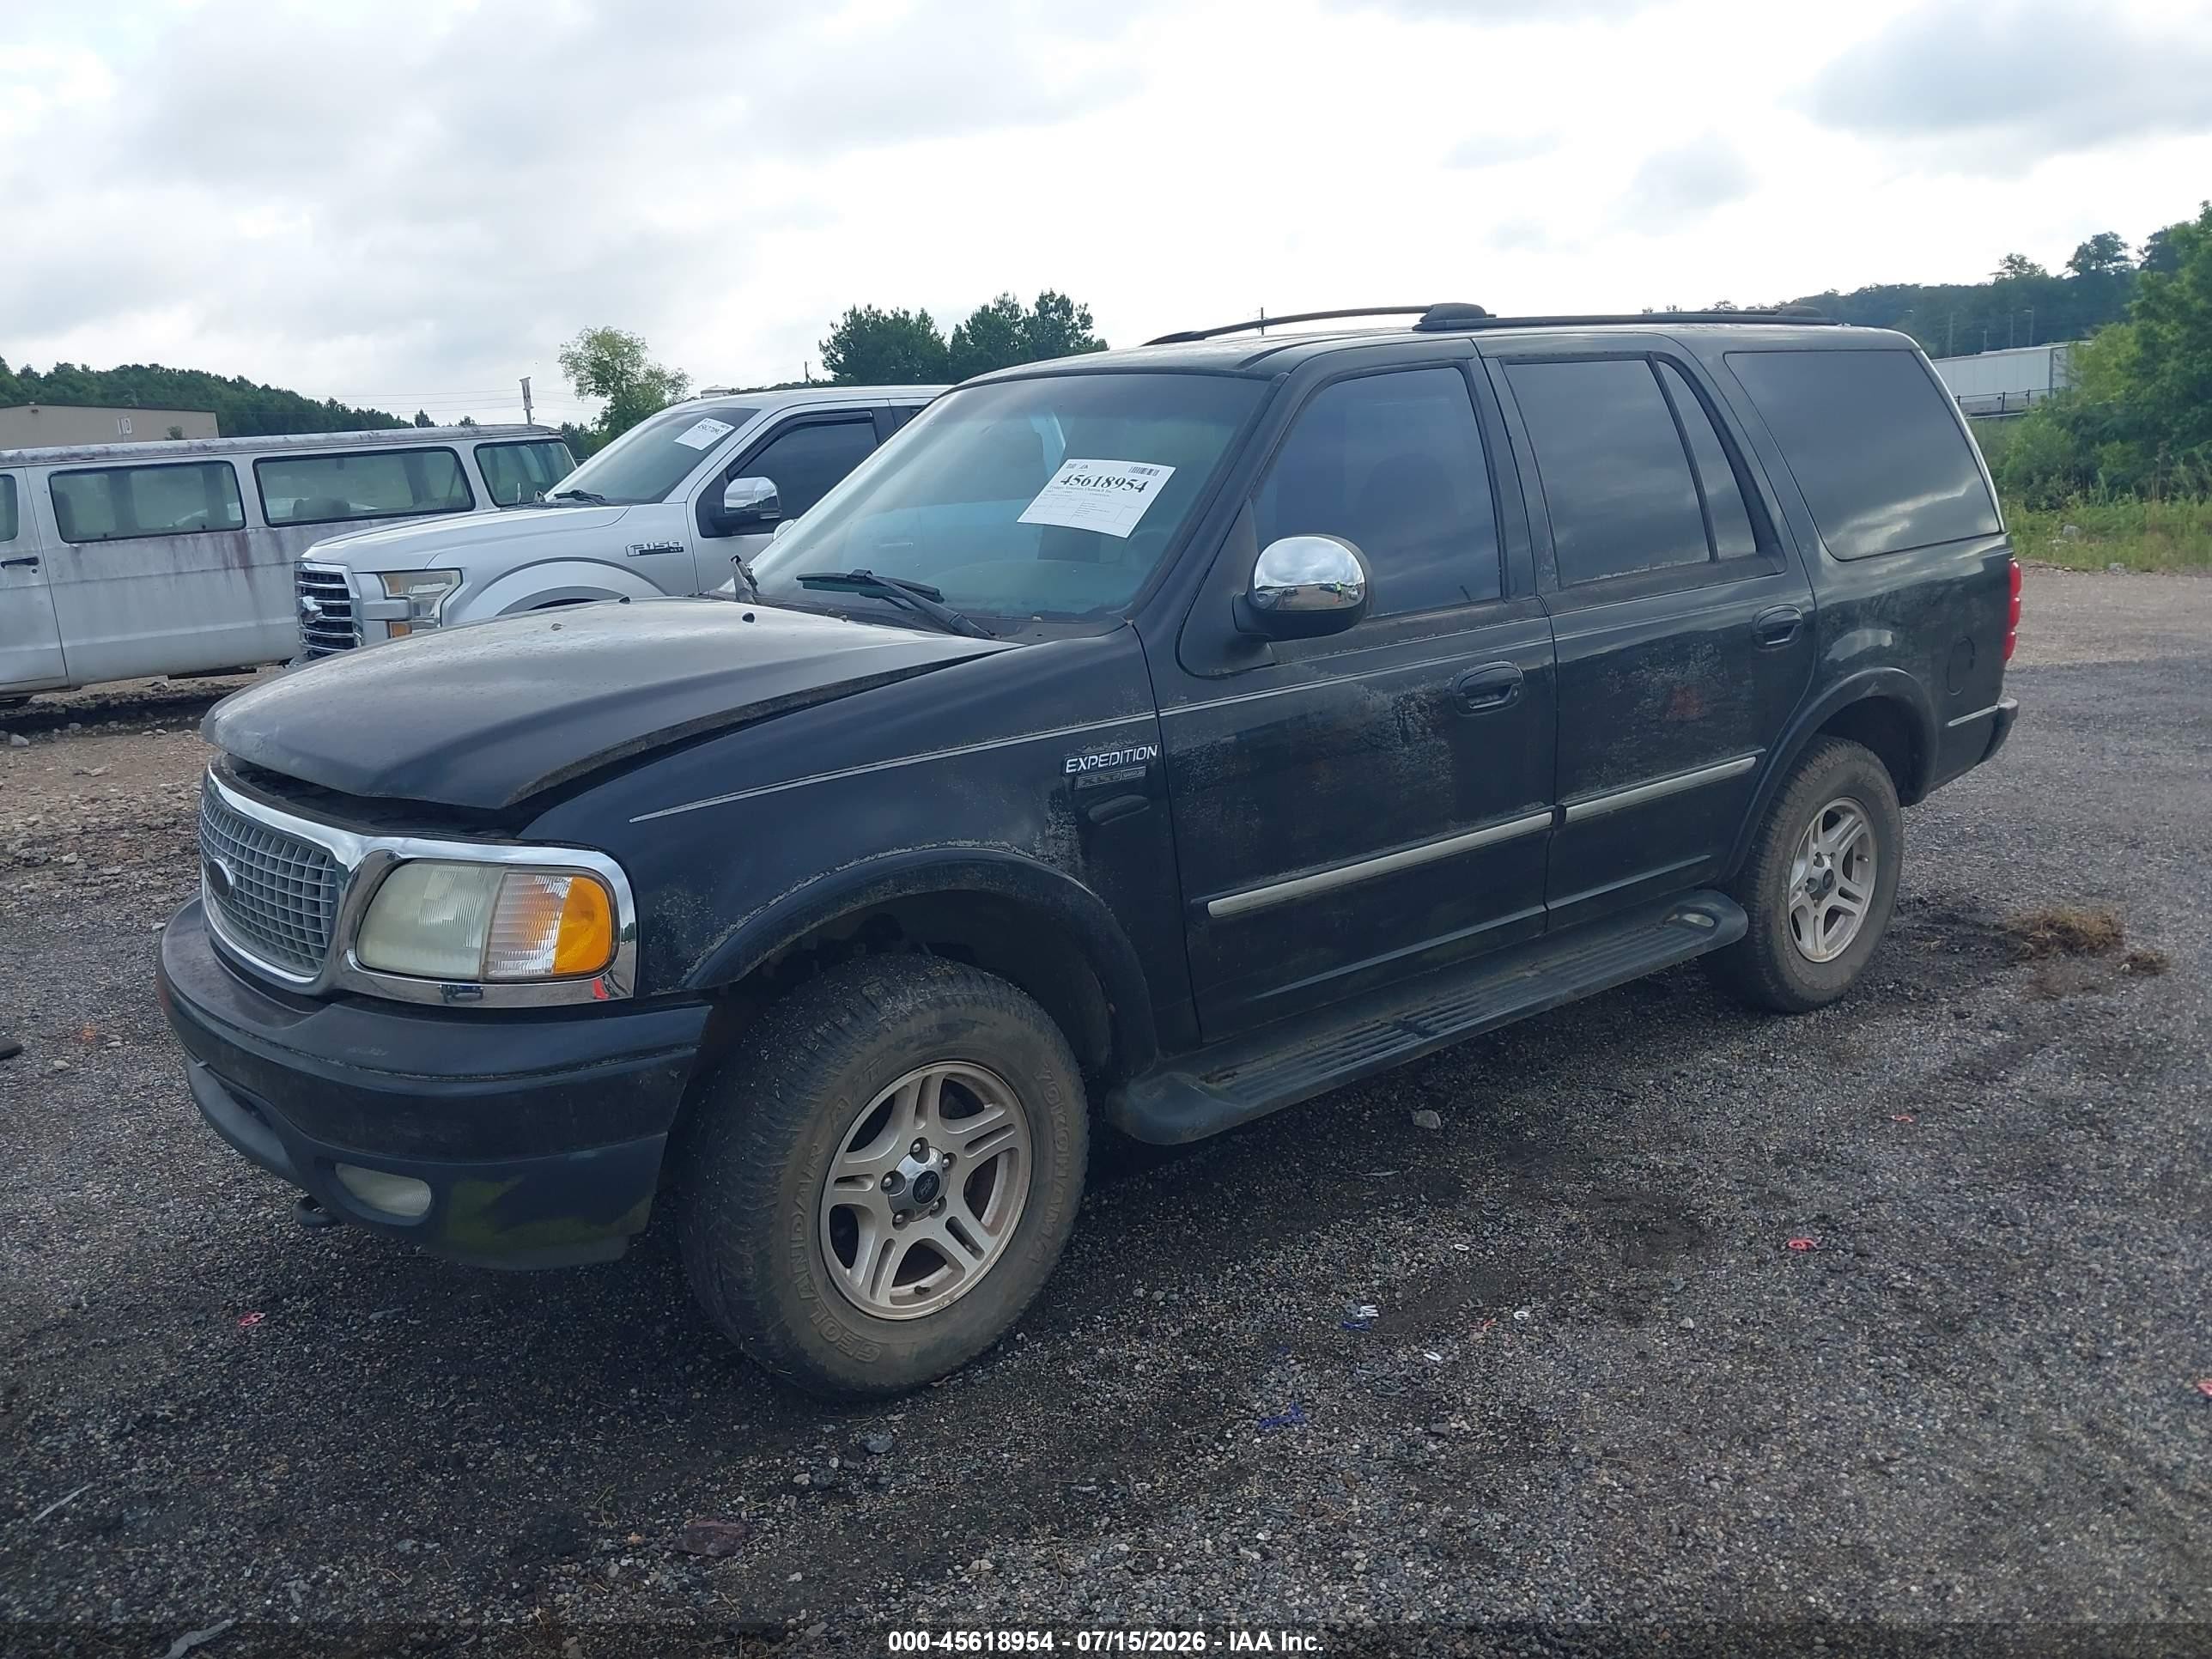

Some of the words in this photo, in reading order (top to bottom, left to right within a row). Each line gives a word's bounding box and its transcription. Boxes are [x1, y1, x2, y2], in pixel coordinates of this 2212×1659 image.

[1060, 473, 1150, 494] 45618954
[1066, 744, 1158, 774] EXPEDITION
[1028, 1060, 1071, 1263] YOKOHAMA
